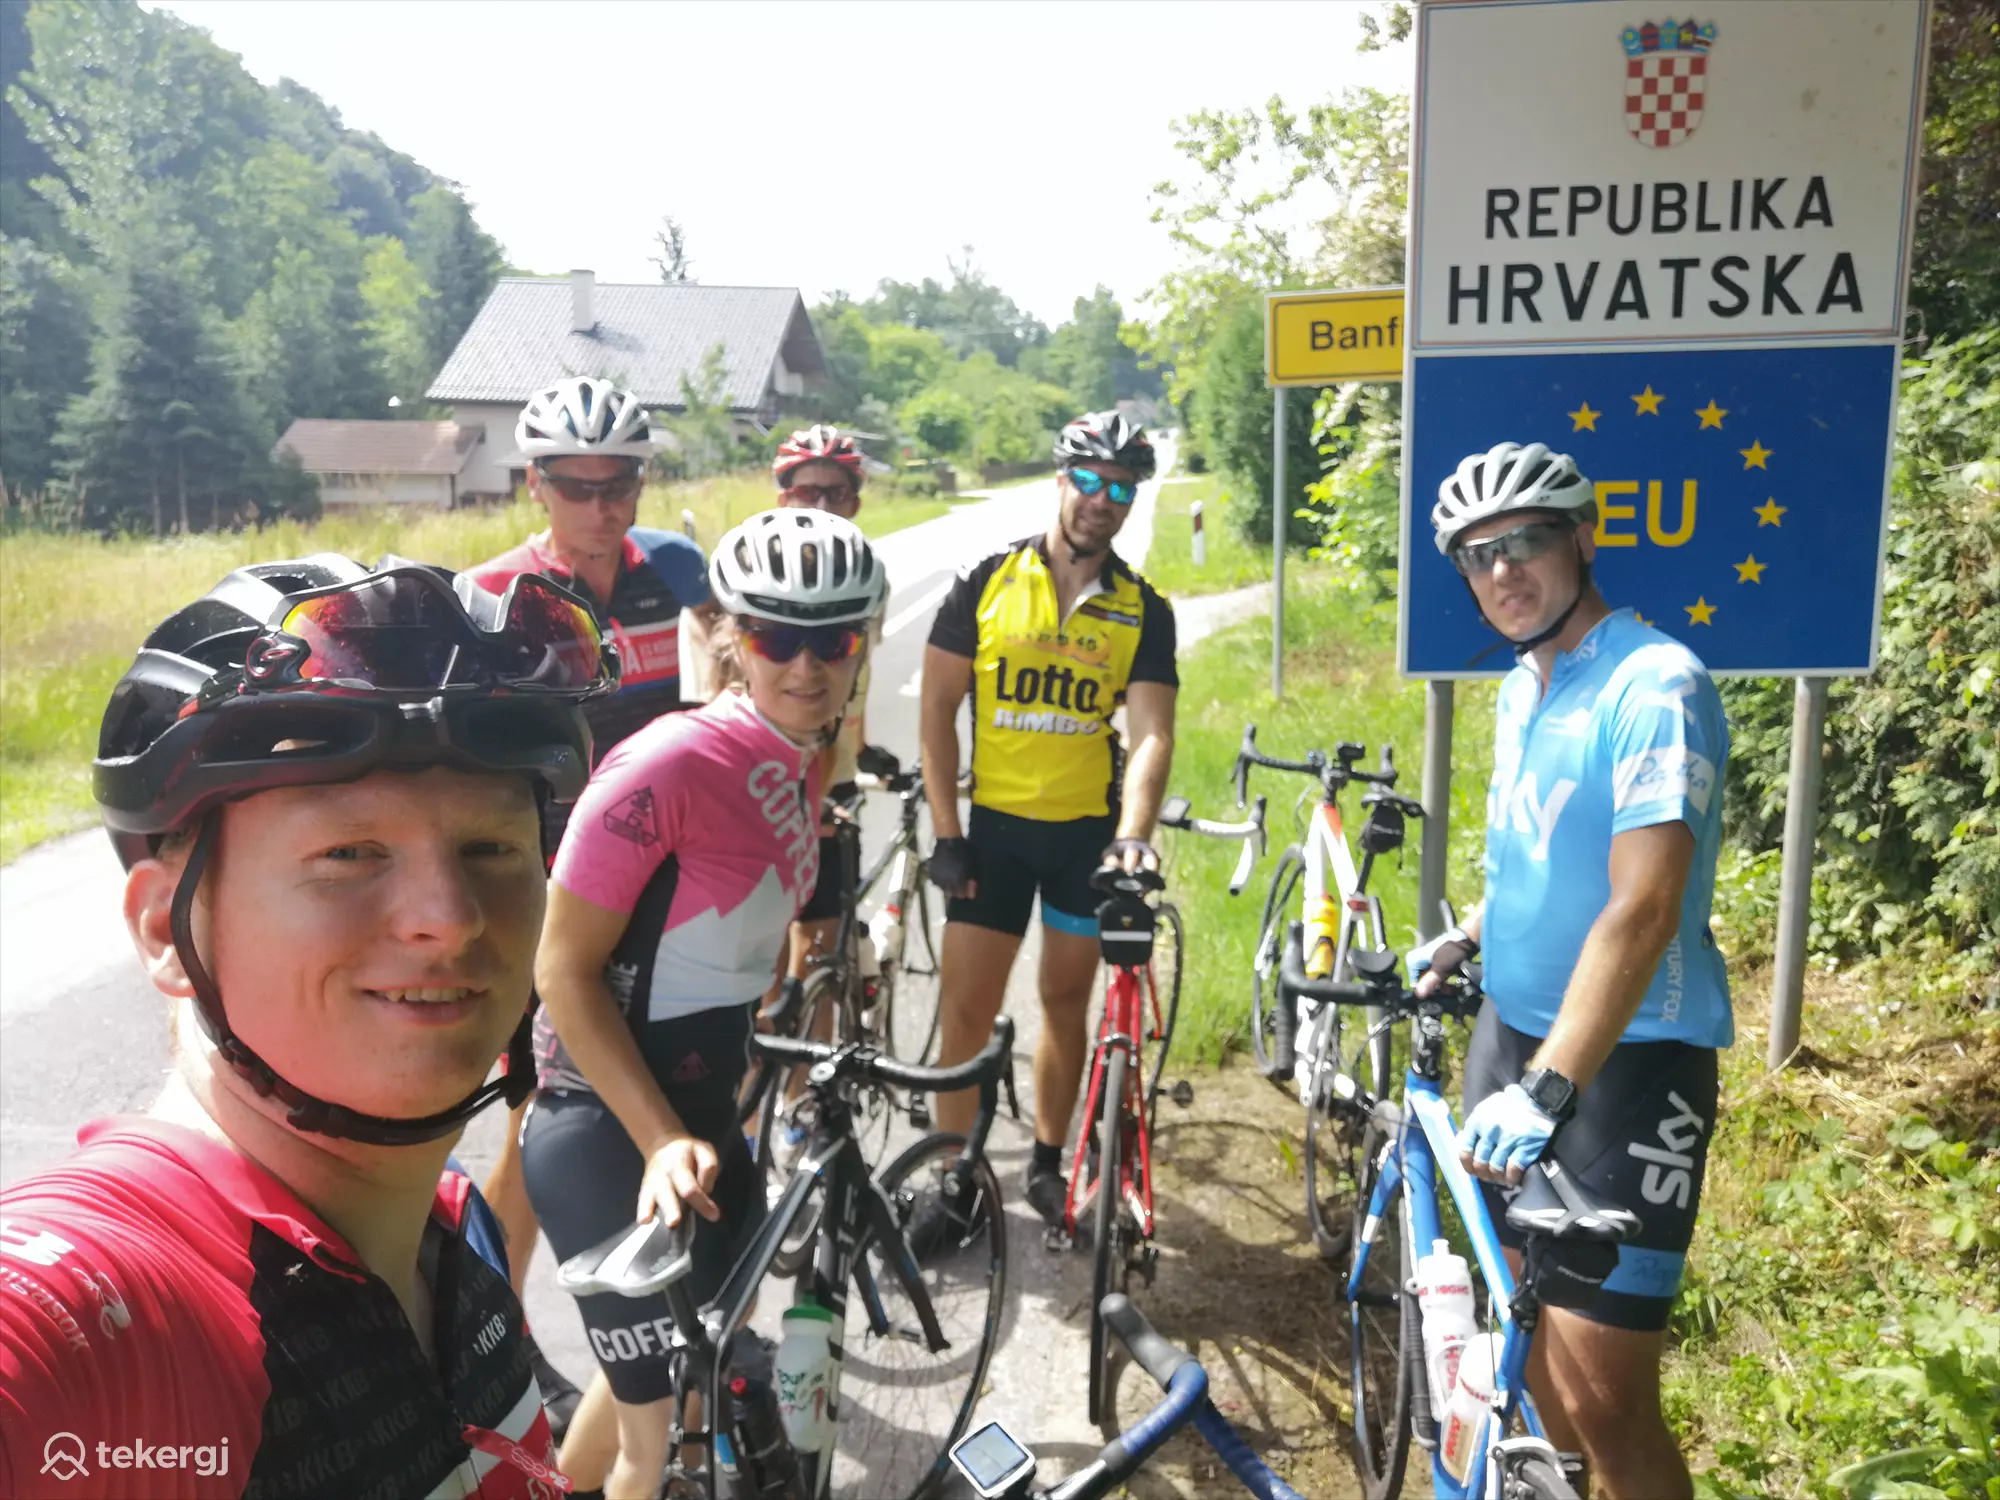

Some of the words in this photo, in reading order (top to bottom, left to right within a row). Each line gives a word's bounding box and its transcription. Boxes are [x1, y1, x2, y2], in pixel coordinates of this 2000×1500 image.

[1485, 175, 1834, 239] REPUBLIKA
[1448, 252, 1863, 325] HRVATSKA
[1311, 316, 1404, 351] Banf
[1593, 479, 1698, 547] EU
[996, 656, 1101, 714] Lotto
[1660, 989, 1684, 1024] FOX
[1627, 1090, 1704, 1210] sky
